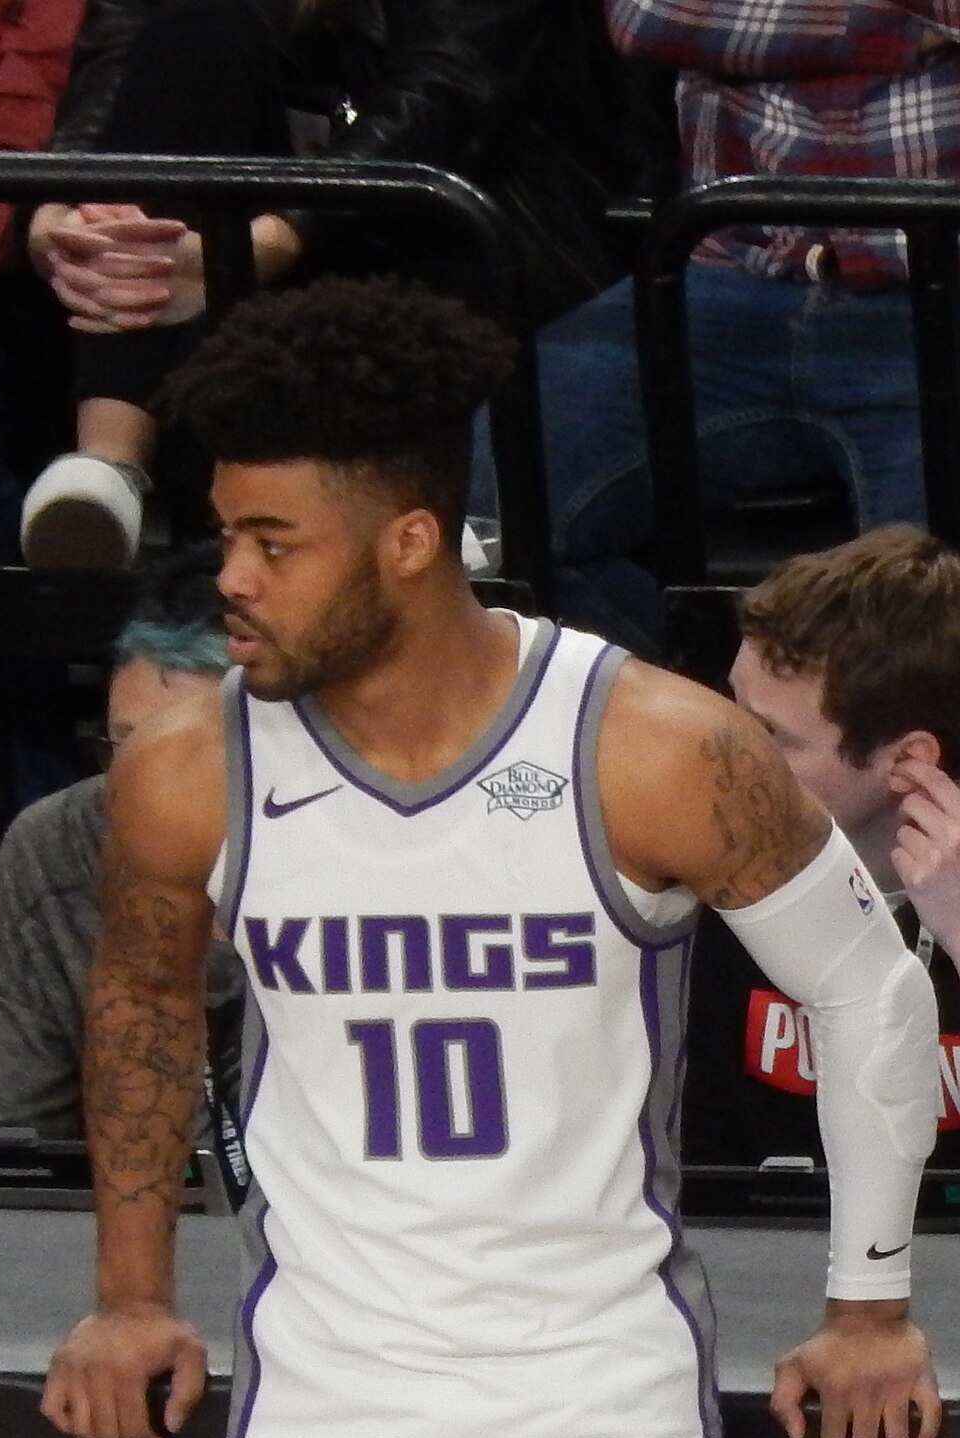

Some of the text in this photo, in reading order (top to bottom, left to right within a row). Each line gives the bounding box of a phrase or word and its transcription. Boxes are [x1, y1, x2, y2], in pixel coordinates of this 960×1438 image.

[490, 780, 559, 794] DIAMOND
[496, 796, 557, 808] ALMONDS
[244, 911, 599, 995] KINGS
[344, 1017, 511, 1162] 10
